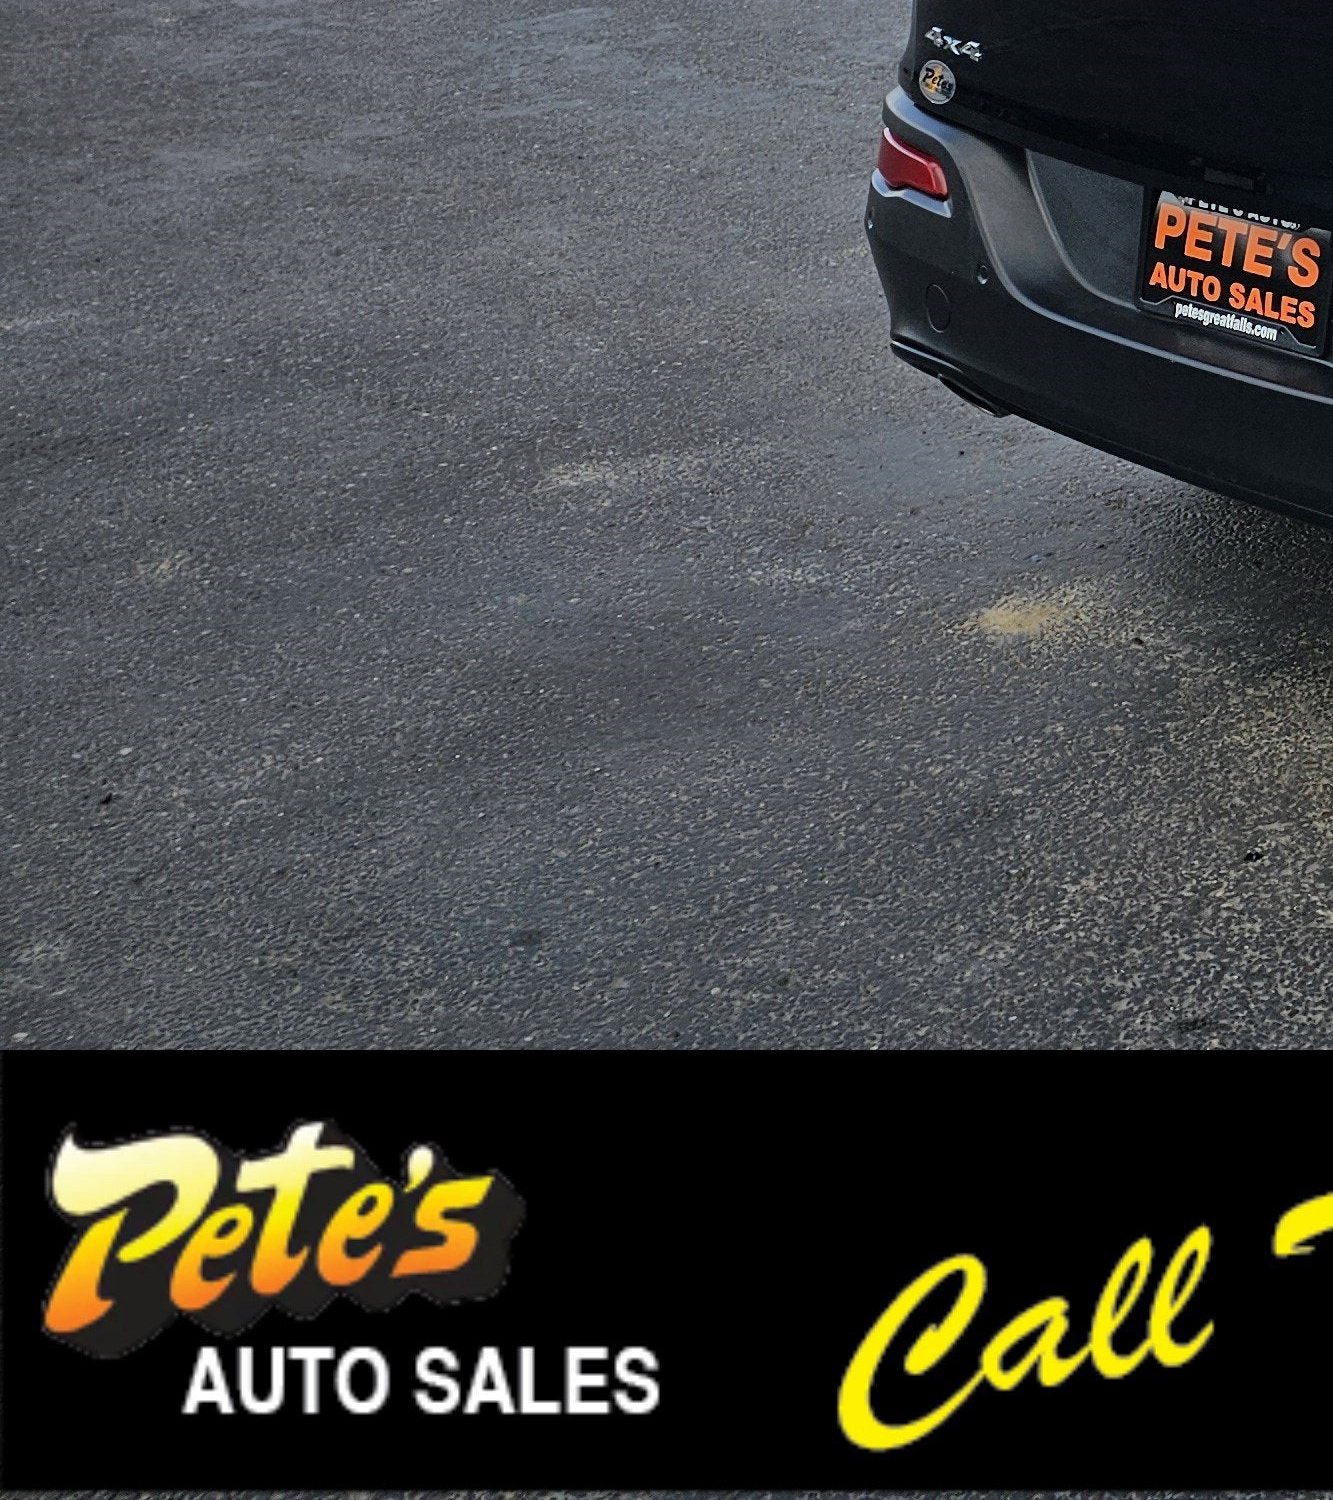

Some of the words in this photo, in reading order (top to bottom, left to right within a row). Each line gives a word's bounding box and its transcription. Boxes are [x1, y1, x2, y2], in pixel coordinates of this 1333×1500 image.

[1154, 202, 1321, 288] PETE'S
[1148, 261, 1222, 302] AUTO
[1228, 281, 1316, 329] SALES
[1174, 301, 1279, 342] petesgreatfalls.com
